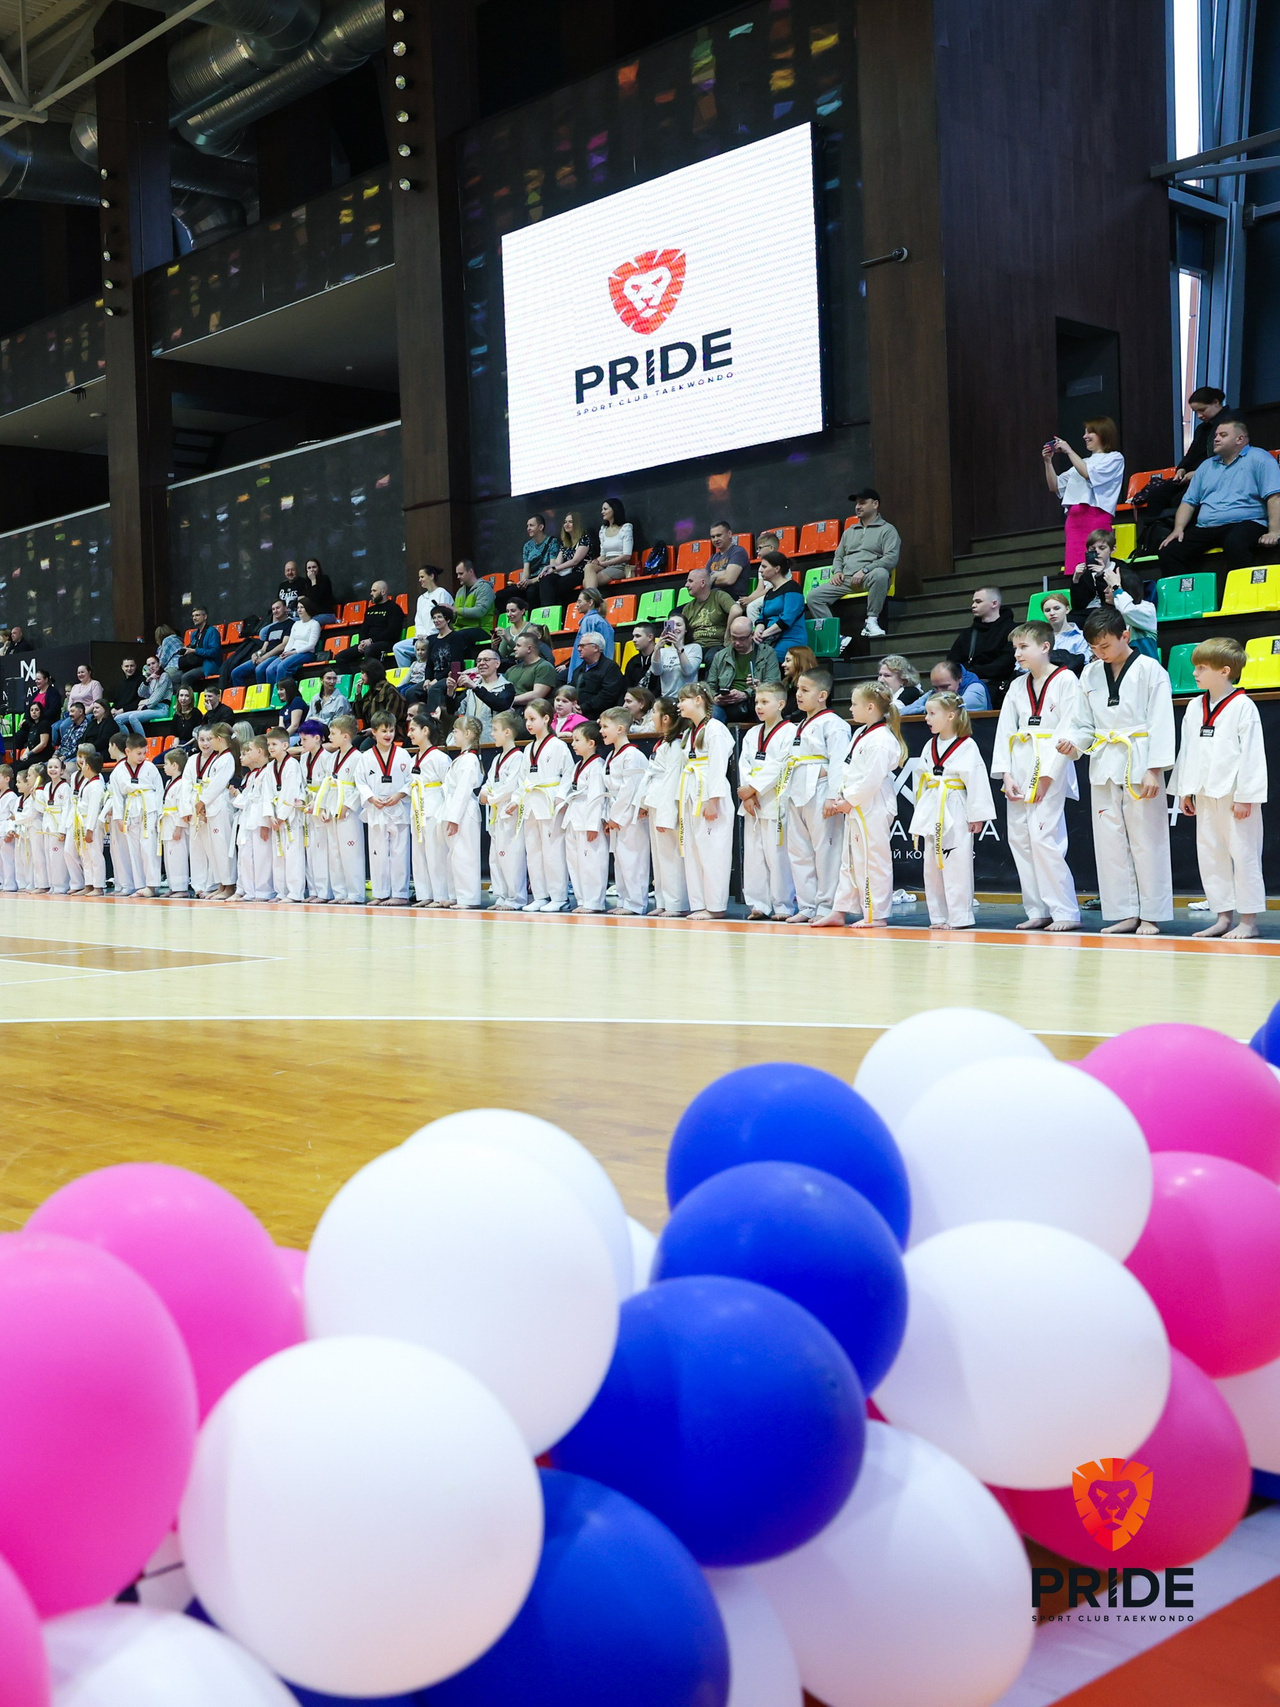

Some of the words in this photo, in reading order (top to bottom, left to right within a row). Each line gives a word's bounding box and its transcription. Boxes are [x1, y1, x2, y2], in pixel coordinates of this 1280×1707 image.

[574, 327, 733, 405] PRIDE
[576, 402, 614, 417] SPORT
[618, 393, 649, 406] CLUB
[654, 371, 734, 397] TAEKWONDO
